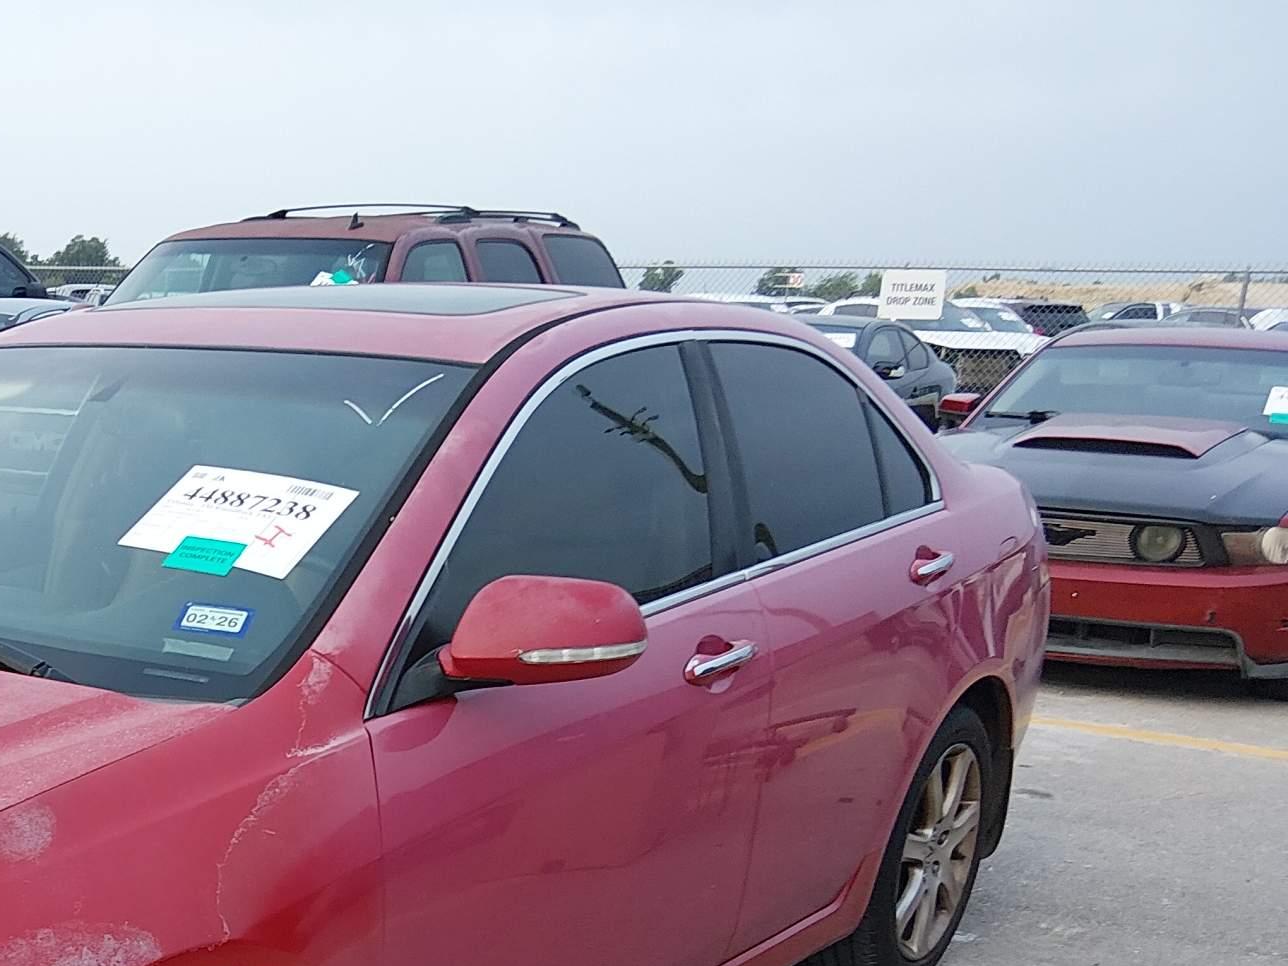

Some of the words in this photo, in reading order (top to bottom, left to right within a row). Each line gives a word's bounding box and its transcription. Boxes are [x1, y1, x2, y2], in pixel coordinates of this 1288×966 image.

[891, 282, 937, 293] TITLEMAX
[886, 296, 911, 306] DROP
[912, 296, 937, 306] ZONE
[183, 486, 317, 521] 44887238
[180, 544, 236, 557] INSPECTION
[178, 551, 228, 564] COMPLETE
